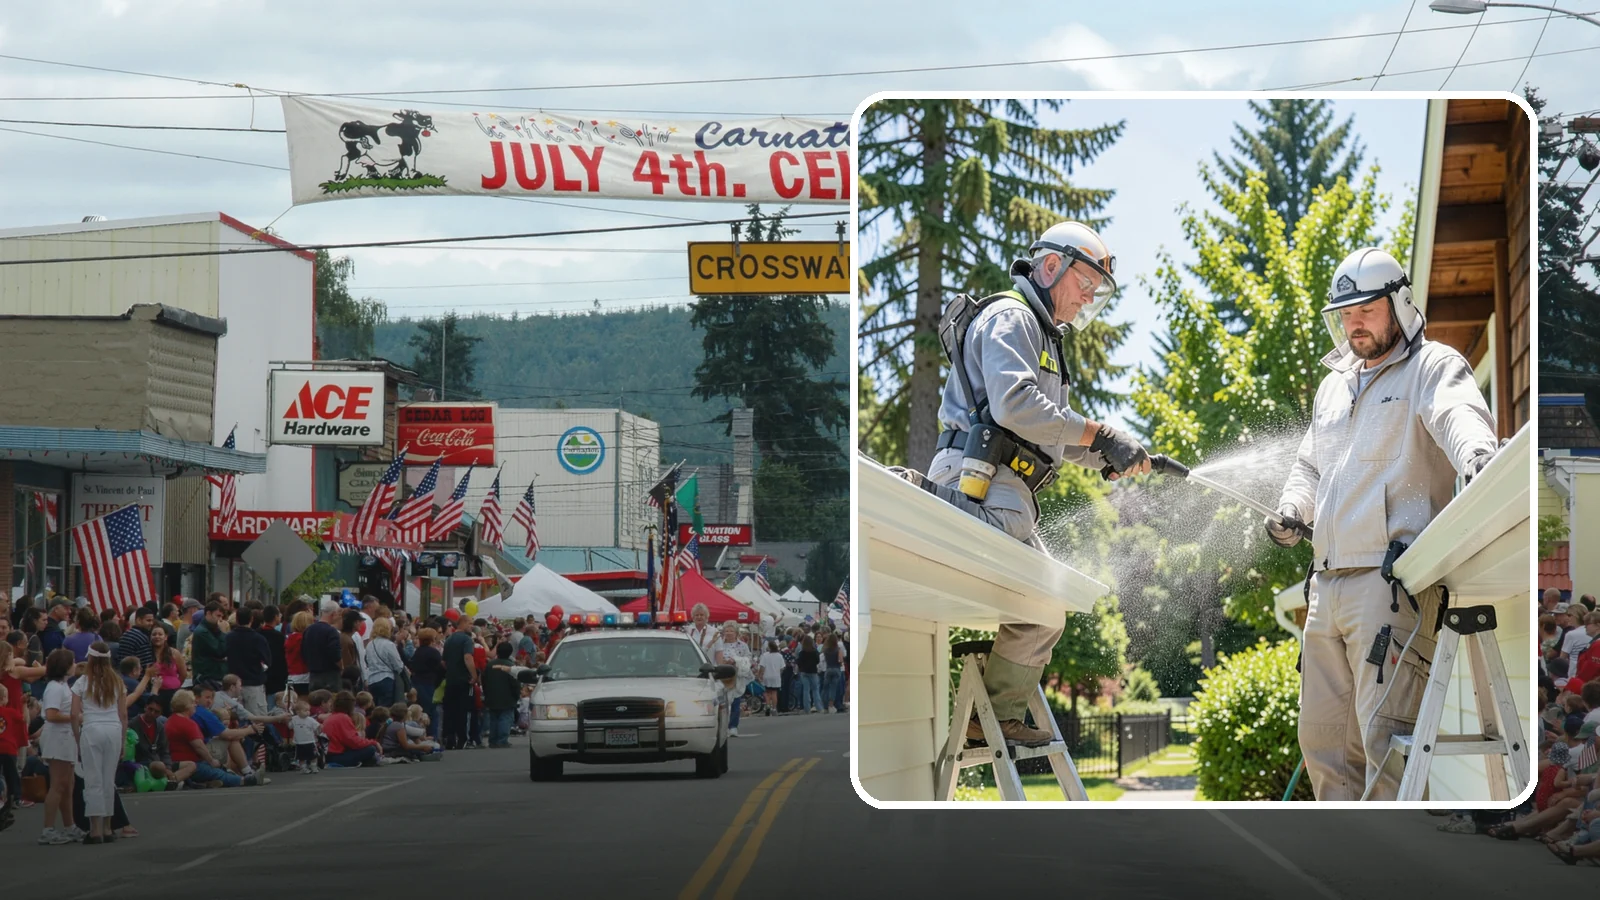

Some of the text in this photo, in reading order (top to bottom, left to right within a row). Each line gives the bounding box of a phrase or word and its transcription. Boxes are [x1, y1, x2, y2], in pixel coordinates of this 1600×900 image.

[694, 121, 850, 150] Carnat
[481, 141, 605, 193] JULY
[632, 150, 746, 198] 4th.
[696, 253, 850, 281] CROSSWA
[283, 380, 373, 420] ACE
[405, 409, 485, 422] CEDAR LOG
[283, 420, 371, 436] Hardware
[416, 428, 477, 447] Coca-Cola
[95, 485, 124, 495] Vincent
[126, 486, 136, 495] de
[137, 486, 155, 496] Paul
[688, 526, 742, 536] CRNATION
[699, 535, 731, 544] GLASS
